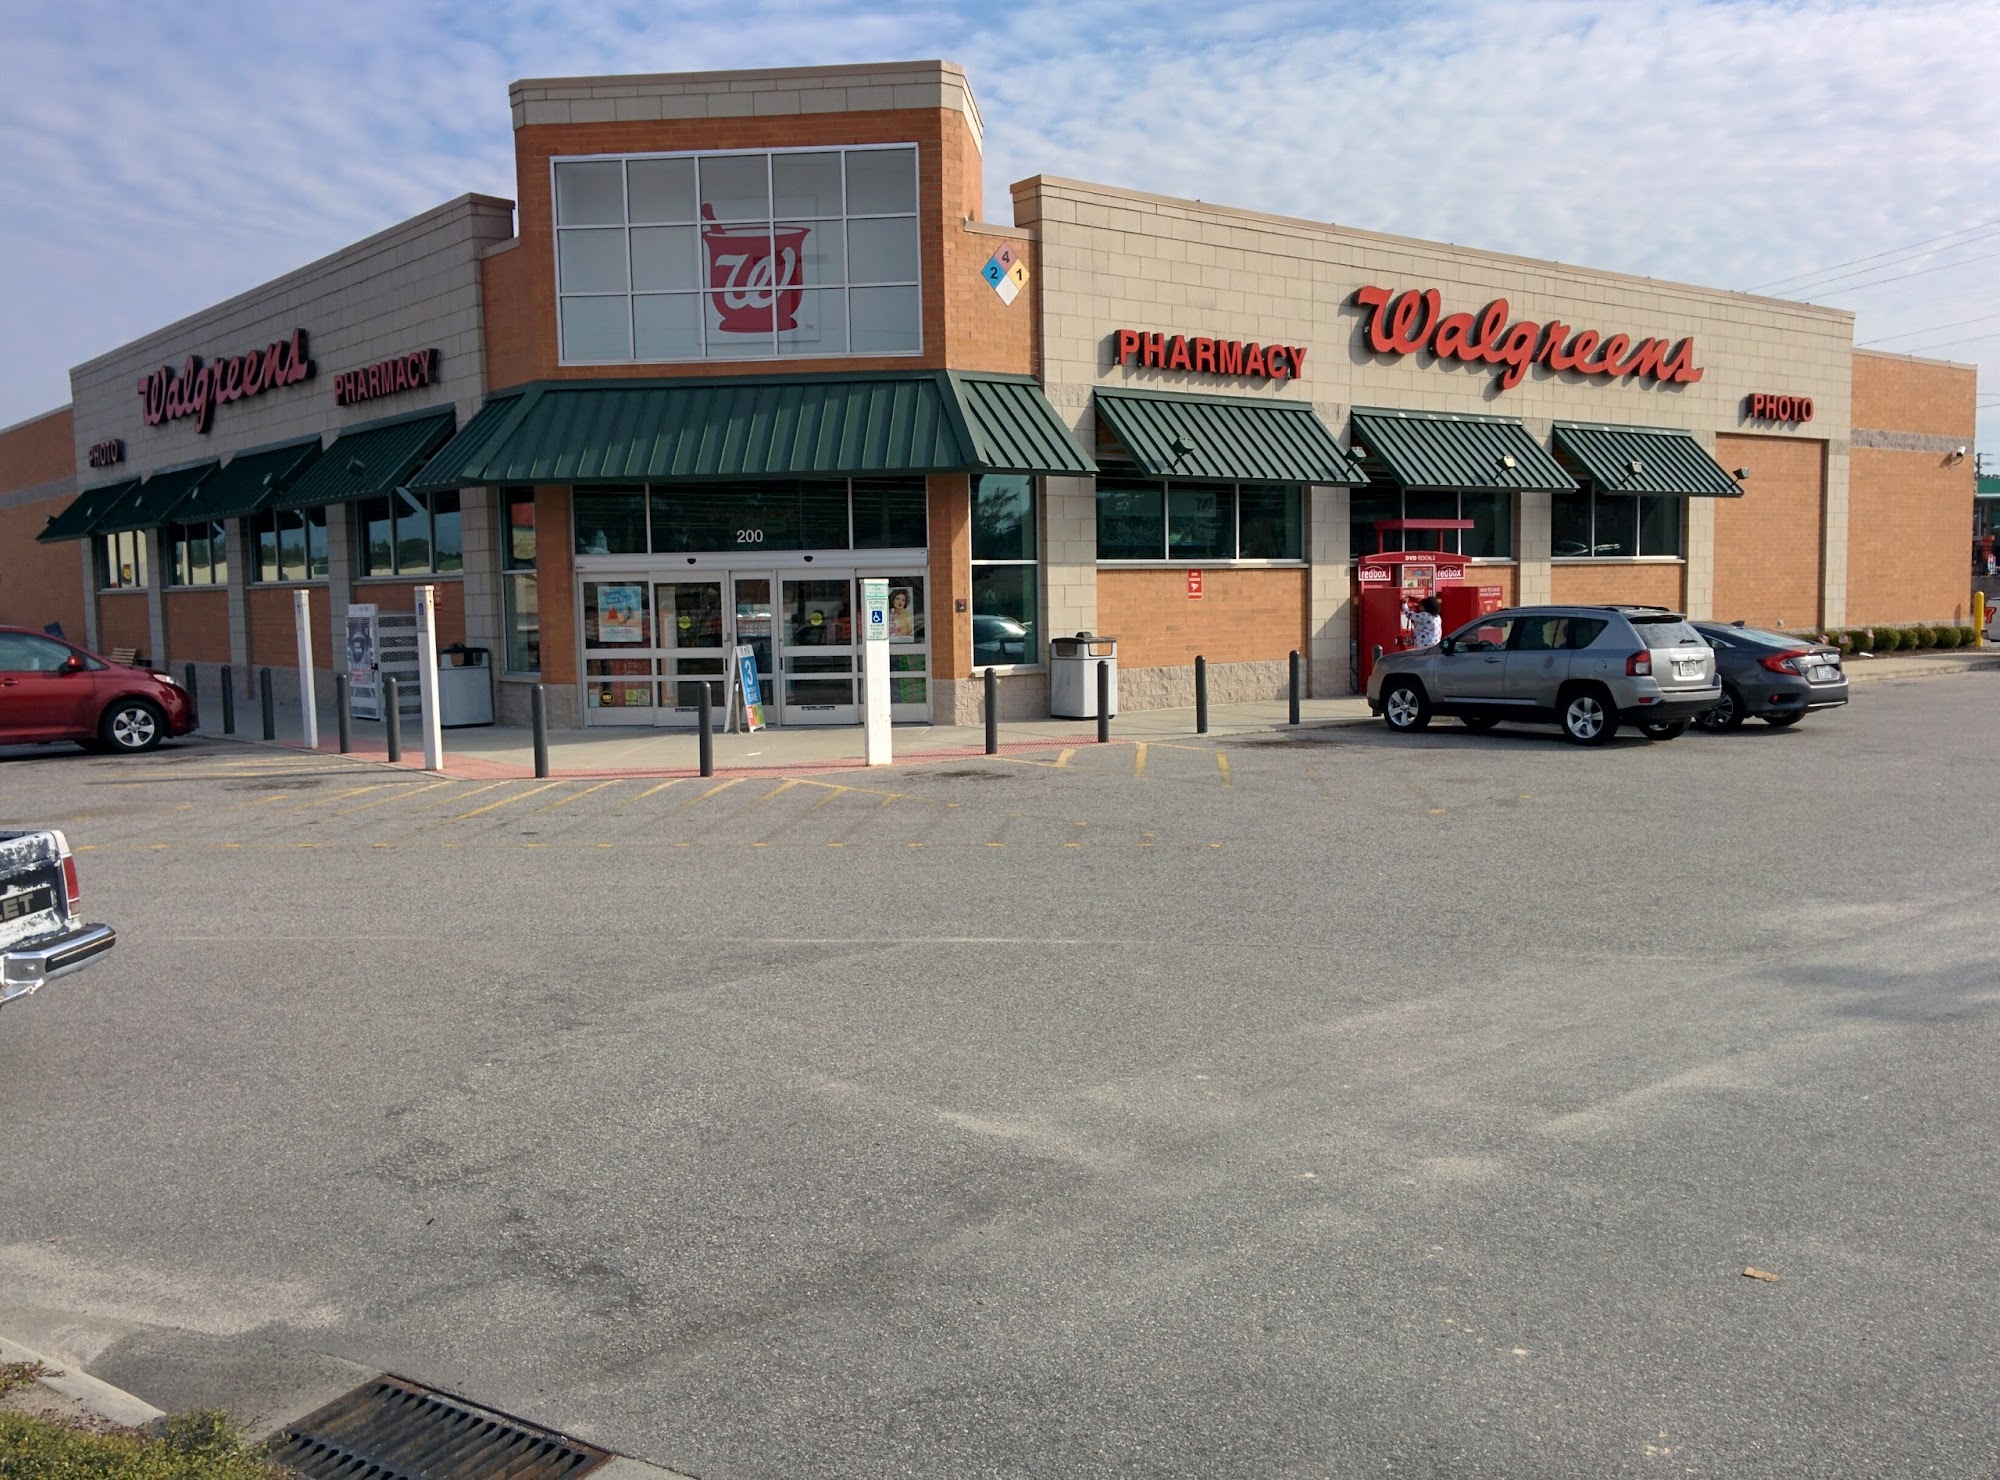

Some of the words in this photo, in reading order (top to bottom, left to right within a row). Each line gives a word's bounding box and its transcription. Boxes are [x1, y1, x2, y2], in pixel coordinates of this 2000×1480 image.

[1001, 250, 1010, 264] 4
[990, 266, 998, 280] 2
[1016, 268, 1022, 281] 1
[1358, 285, 1704, 390] Walgreens
[1117, 329, 1307, 380] PHARMACY
[137, 328, 310, 433] Walgreens
[332, 347, 434, 407] PHARMACY
[1752, 392, 1815, 423] PHOTO
[88, 438, 119, 468] PHOTO
[736, 529, 764, 543] 200
[1361, 568, 1388, 579] redbox
[1437, 567, 1462, 578] redbox
[745, 660, 754, 686] 3
[0, 892, 34, 921] ET
